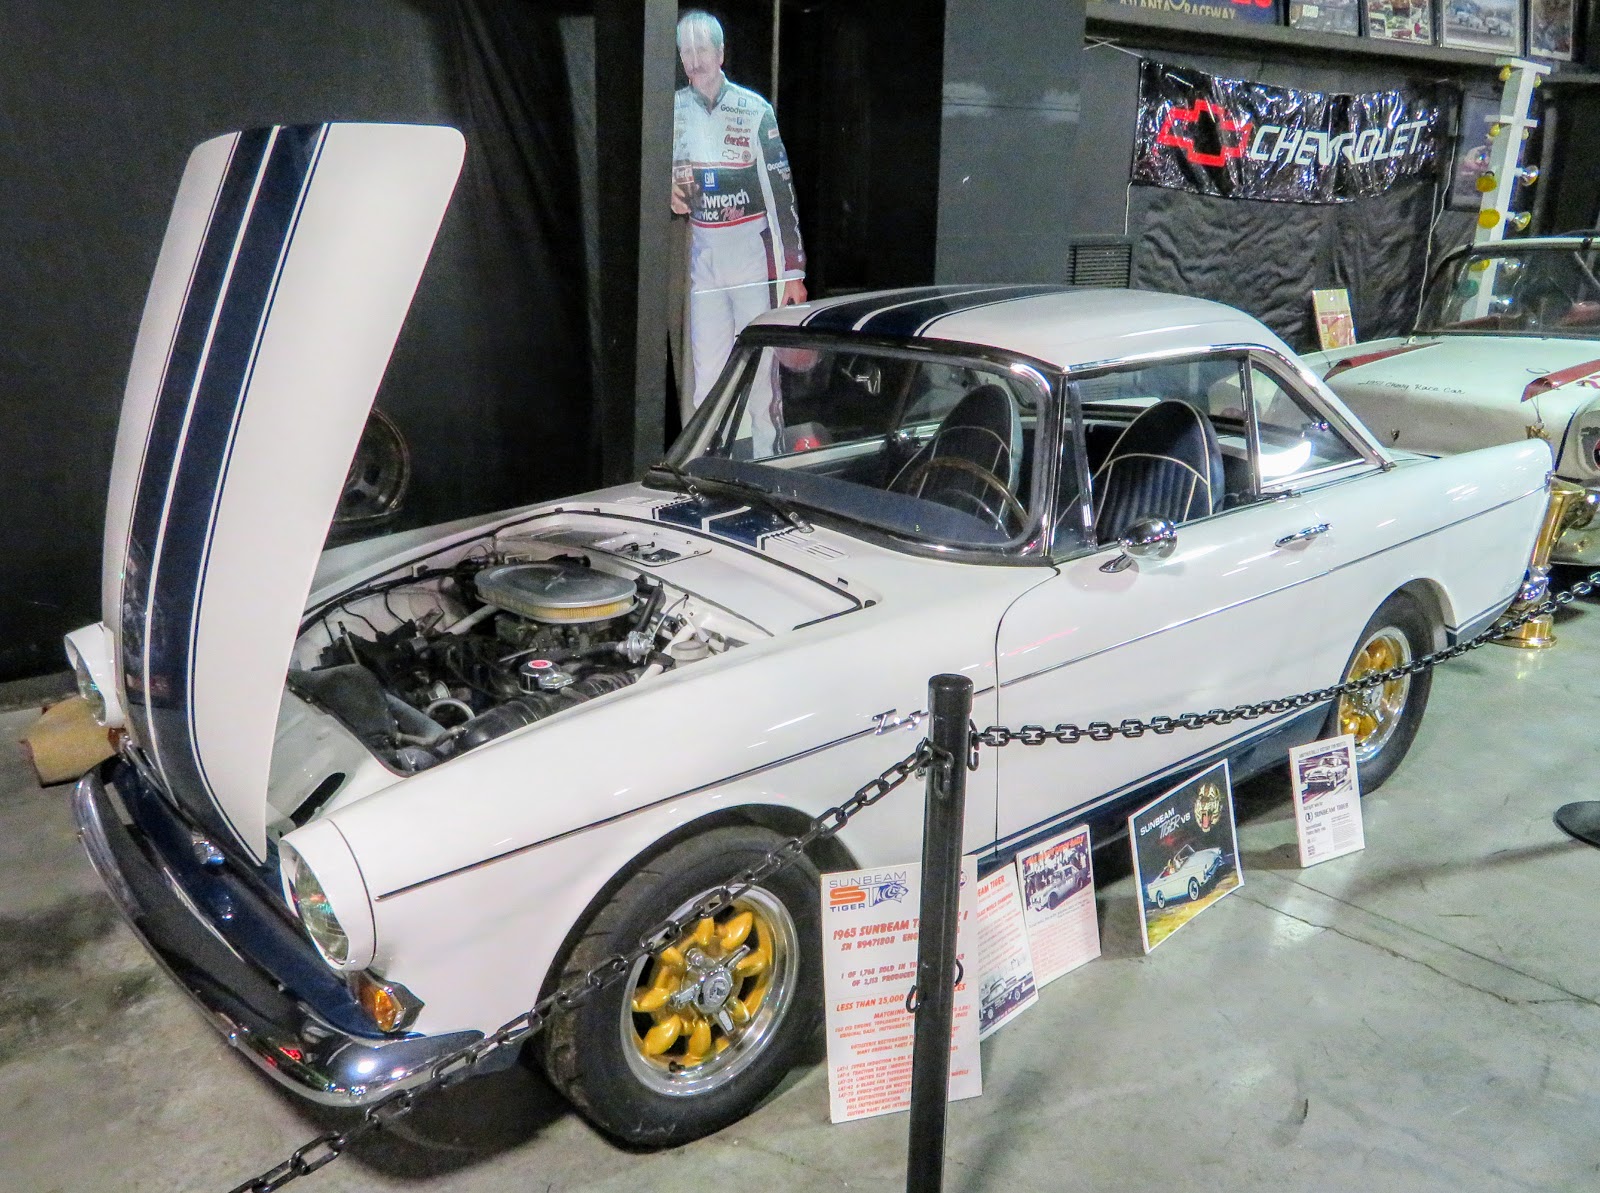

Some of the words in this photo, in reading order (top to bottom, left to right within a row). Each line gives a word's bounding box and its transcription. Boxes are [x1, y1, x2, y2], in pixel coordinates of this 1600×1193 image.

[1184, 2, 1236, 19] RACEWAY
[1250, 120, 1428, 166] CHEVROLET
[704, 172, 716, 184] GM
[702, 188, 750, 209] dwrench
[1415, 383, 1438, 391] Race
[1140, 807, 1175, 836] SUNBEAM
[1159, 814, 1181, 840] TIGER
[1181, 812, 1191, 824] V8
[829, 871, 907, 889] SUNBEAM
[990, 874, 1005, 889] TIGER
[829, 902, 866, 913] TIGER
[833, 927, 857, 941] 1965
[859, 920, 910, 937] SUNBEAM
[847, 970, 857, 978] OF
[852, 979, 861, 987] OF
[882, 970, 915, 982] PRODUCED
[836, 1002, 853, 1012] LESS
[856, 998, 876, 1008] THAN
[878, 993, 904, 1005] 25,000
[874, 1008, 906, 1019] MATCHING
